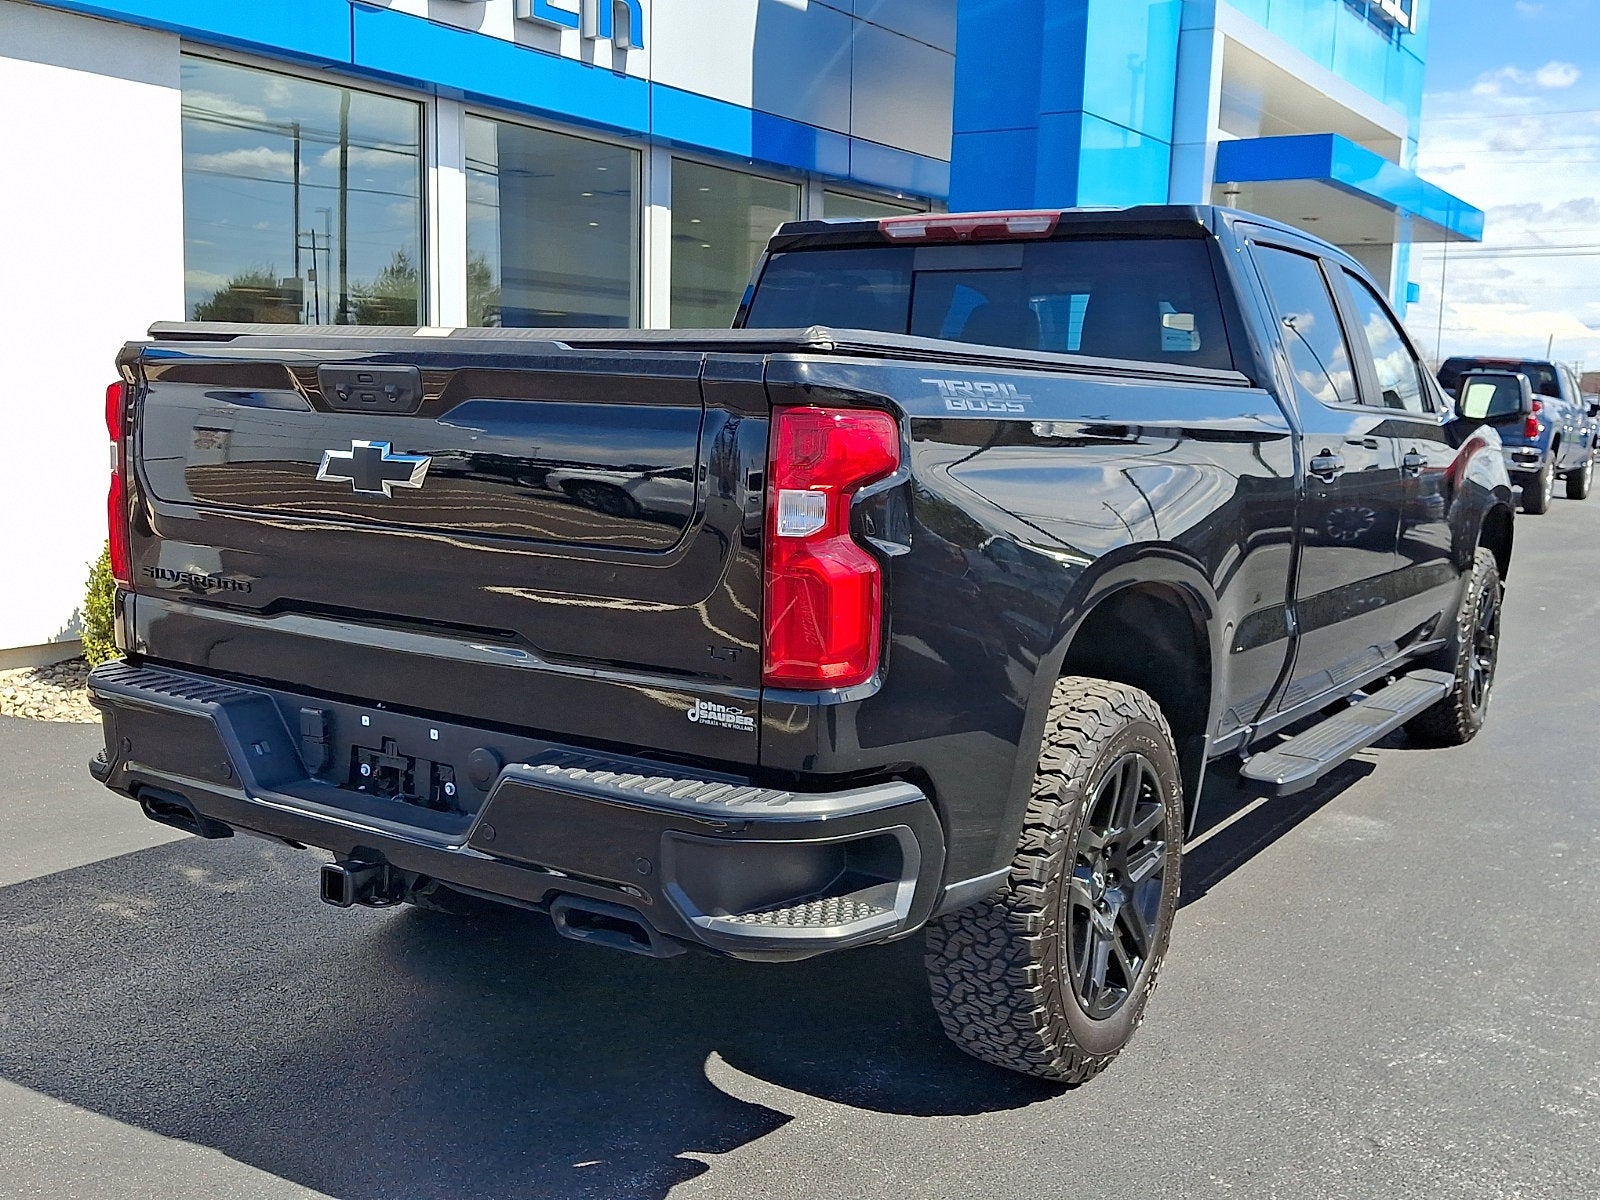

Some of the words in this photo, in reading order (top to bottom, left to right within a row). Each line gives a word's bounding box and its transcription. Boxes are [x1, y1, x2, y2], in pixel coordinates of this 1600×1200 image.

[920, 378, 1034, 401] TRAIL
[944, 397, 1025, 413] BOSS
[706, 645, 743, 663] LT
[687, 698, 726, 722] John
[699, 709, 755, 727] SAUDER
